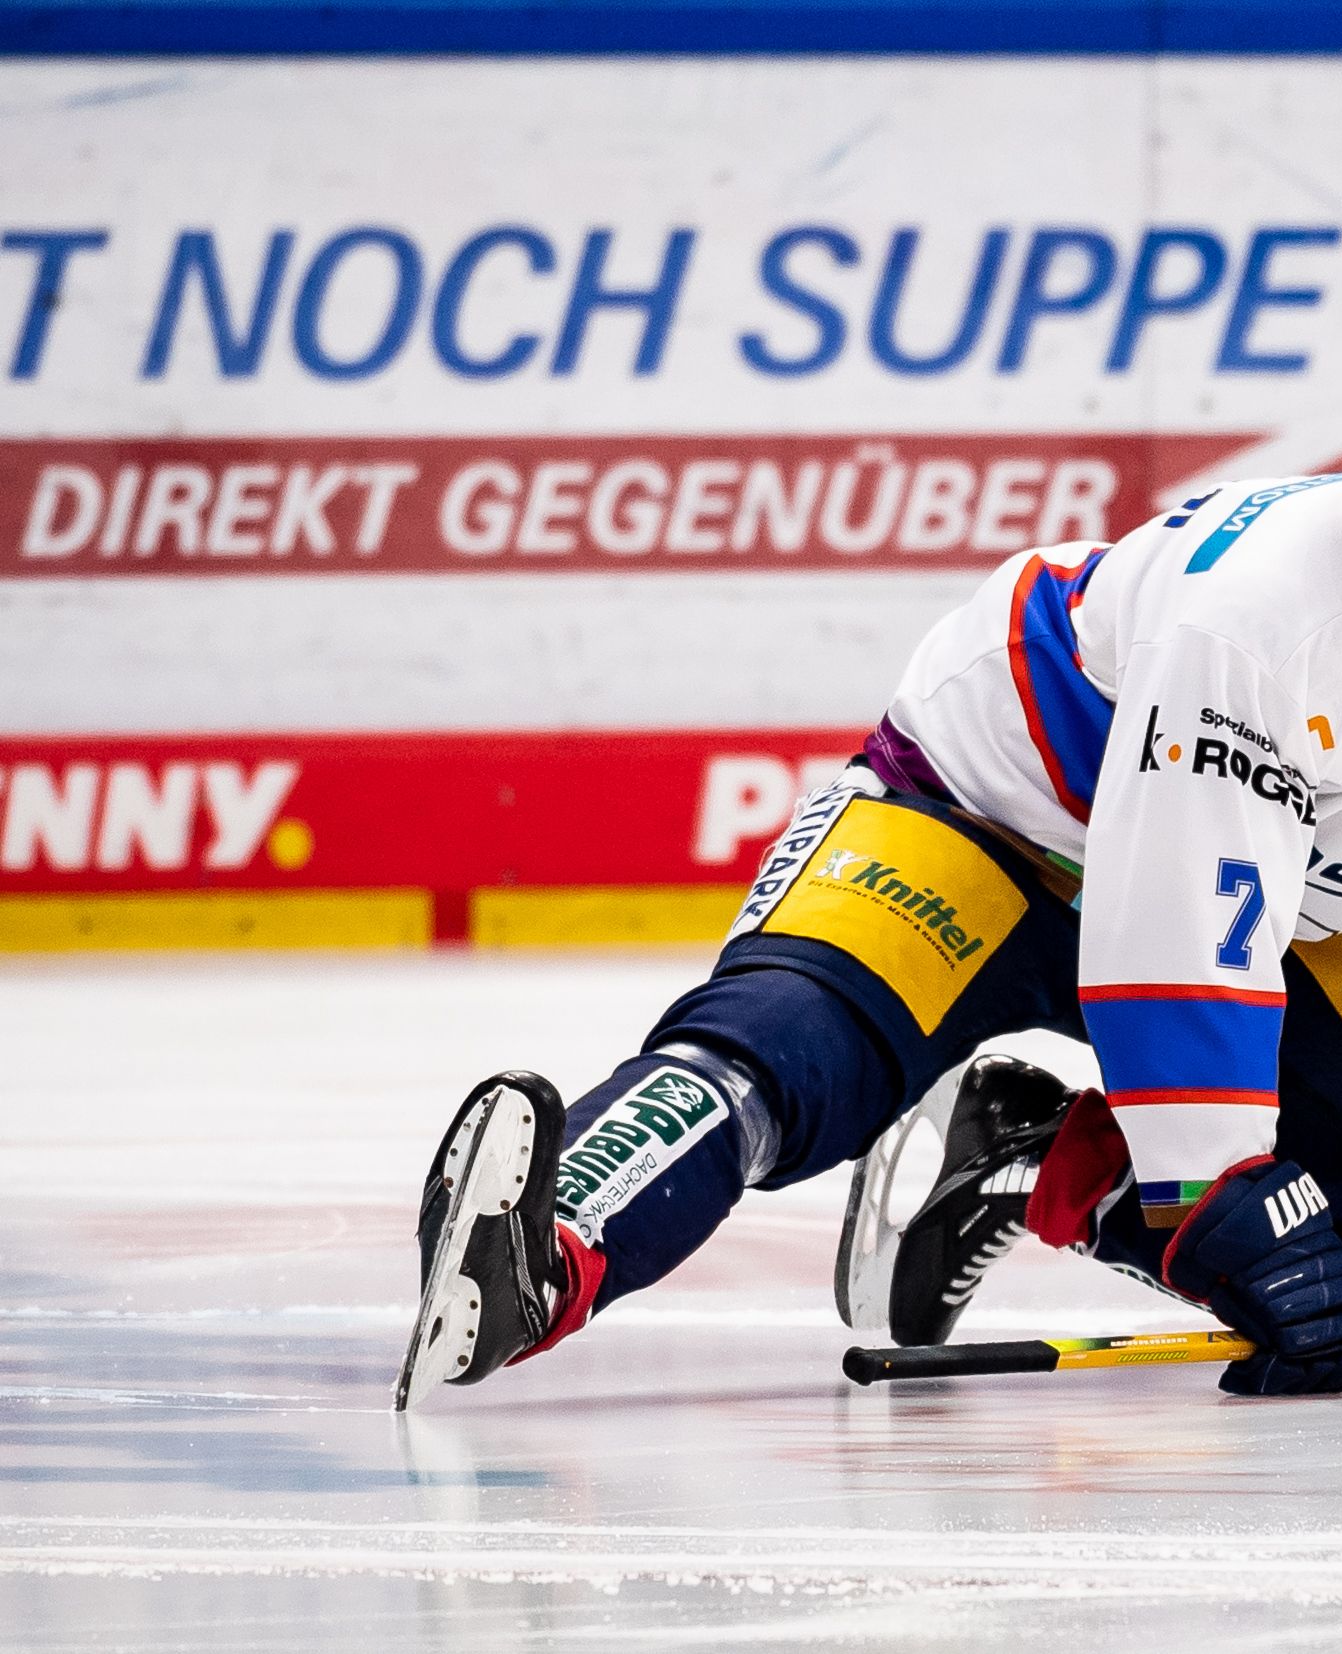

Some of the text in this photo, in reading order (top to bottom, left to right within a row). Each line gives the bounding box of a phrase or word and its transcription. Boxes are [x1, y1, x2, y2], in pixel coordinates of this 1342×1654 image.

[138, 223, 697, 380] NOCH
[736, 223, 1342, 379] SUPPE
[19, 442, 1122, 559] DIREKT GEGENÜBER
[850, 861, 985, 962] Knittel
[1216, 858, 1267, 970] 7
[1264, 1172, 1329, 1238] WA
